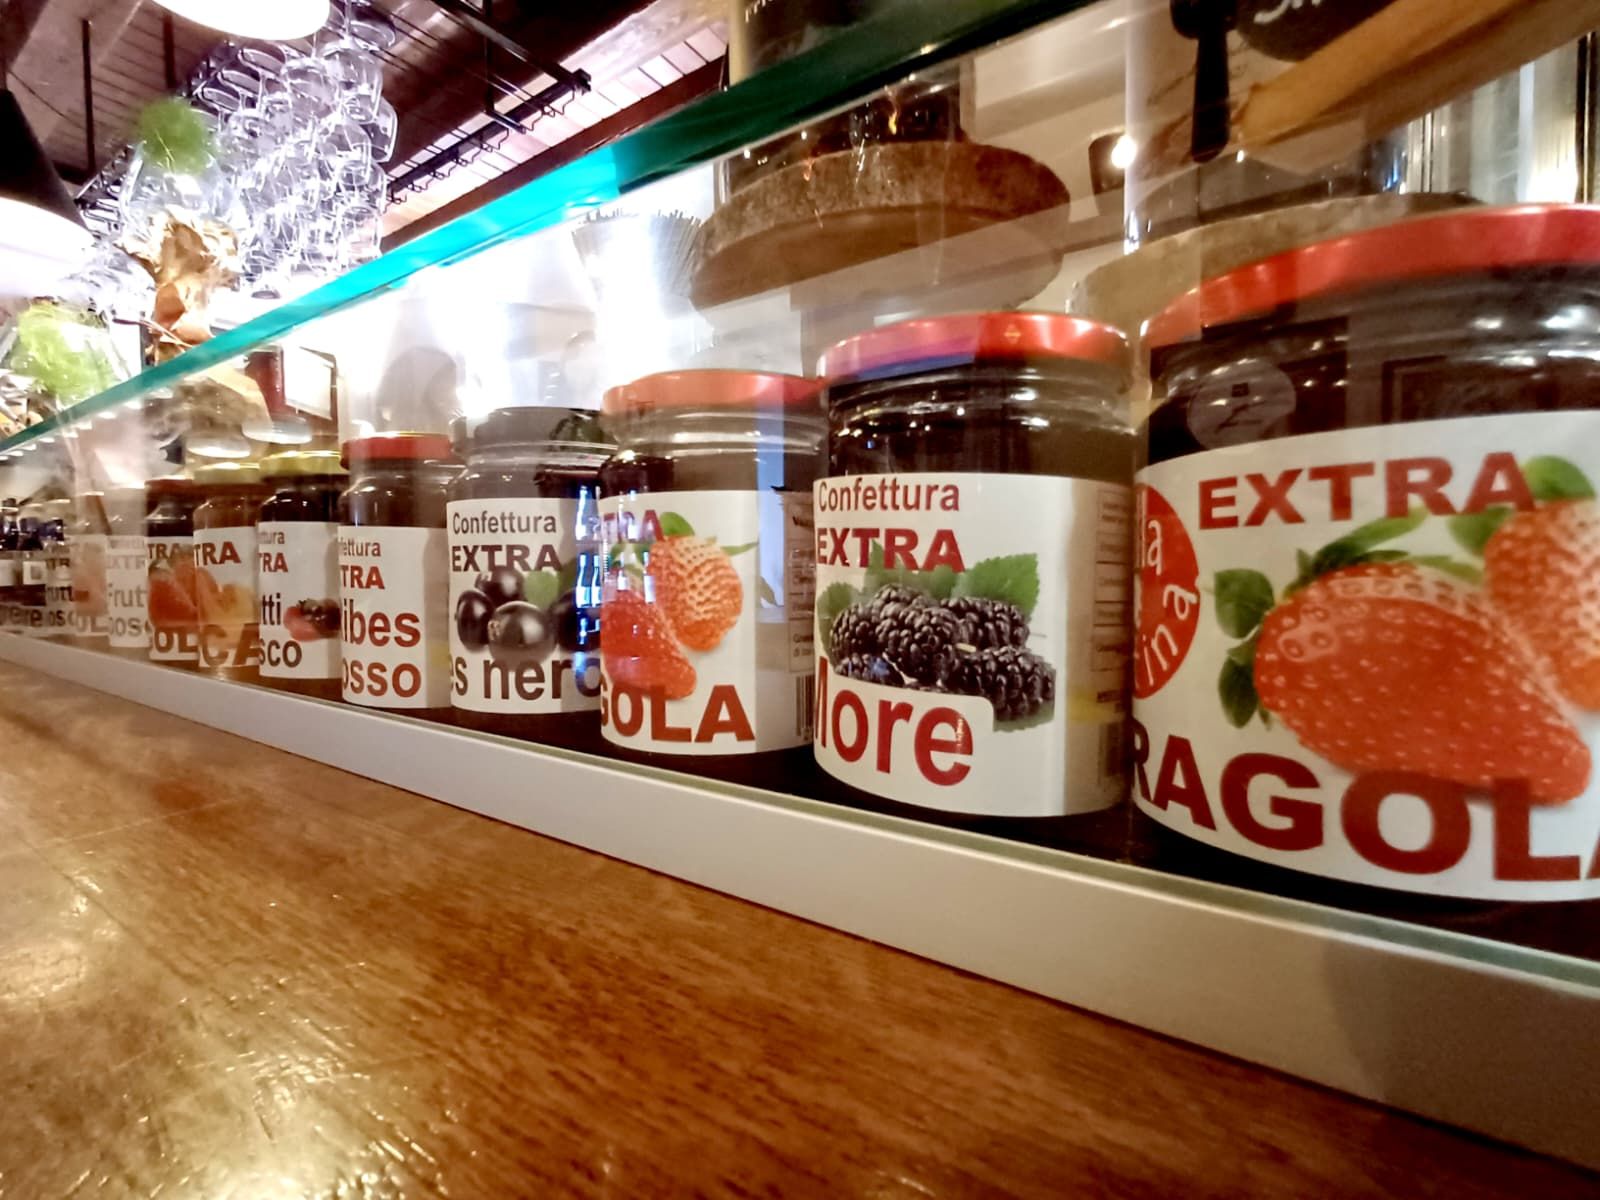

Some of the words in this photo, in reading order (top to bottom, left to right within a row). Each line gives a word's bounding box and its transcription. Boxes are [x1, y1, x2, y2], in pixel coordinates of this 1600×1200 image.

[818, 477, 960, 513] Confettura
[1199, 452, 1536, 530] EXTRA
[452, 511, 557, 534] Confettura
[452, 544, 563, 572] EXTRA
[817, 527, 966, 573] EXTRA
[1133, 717, 1600, 883] RAGOL
